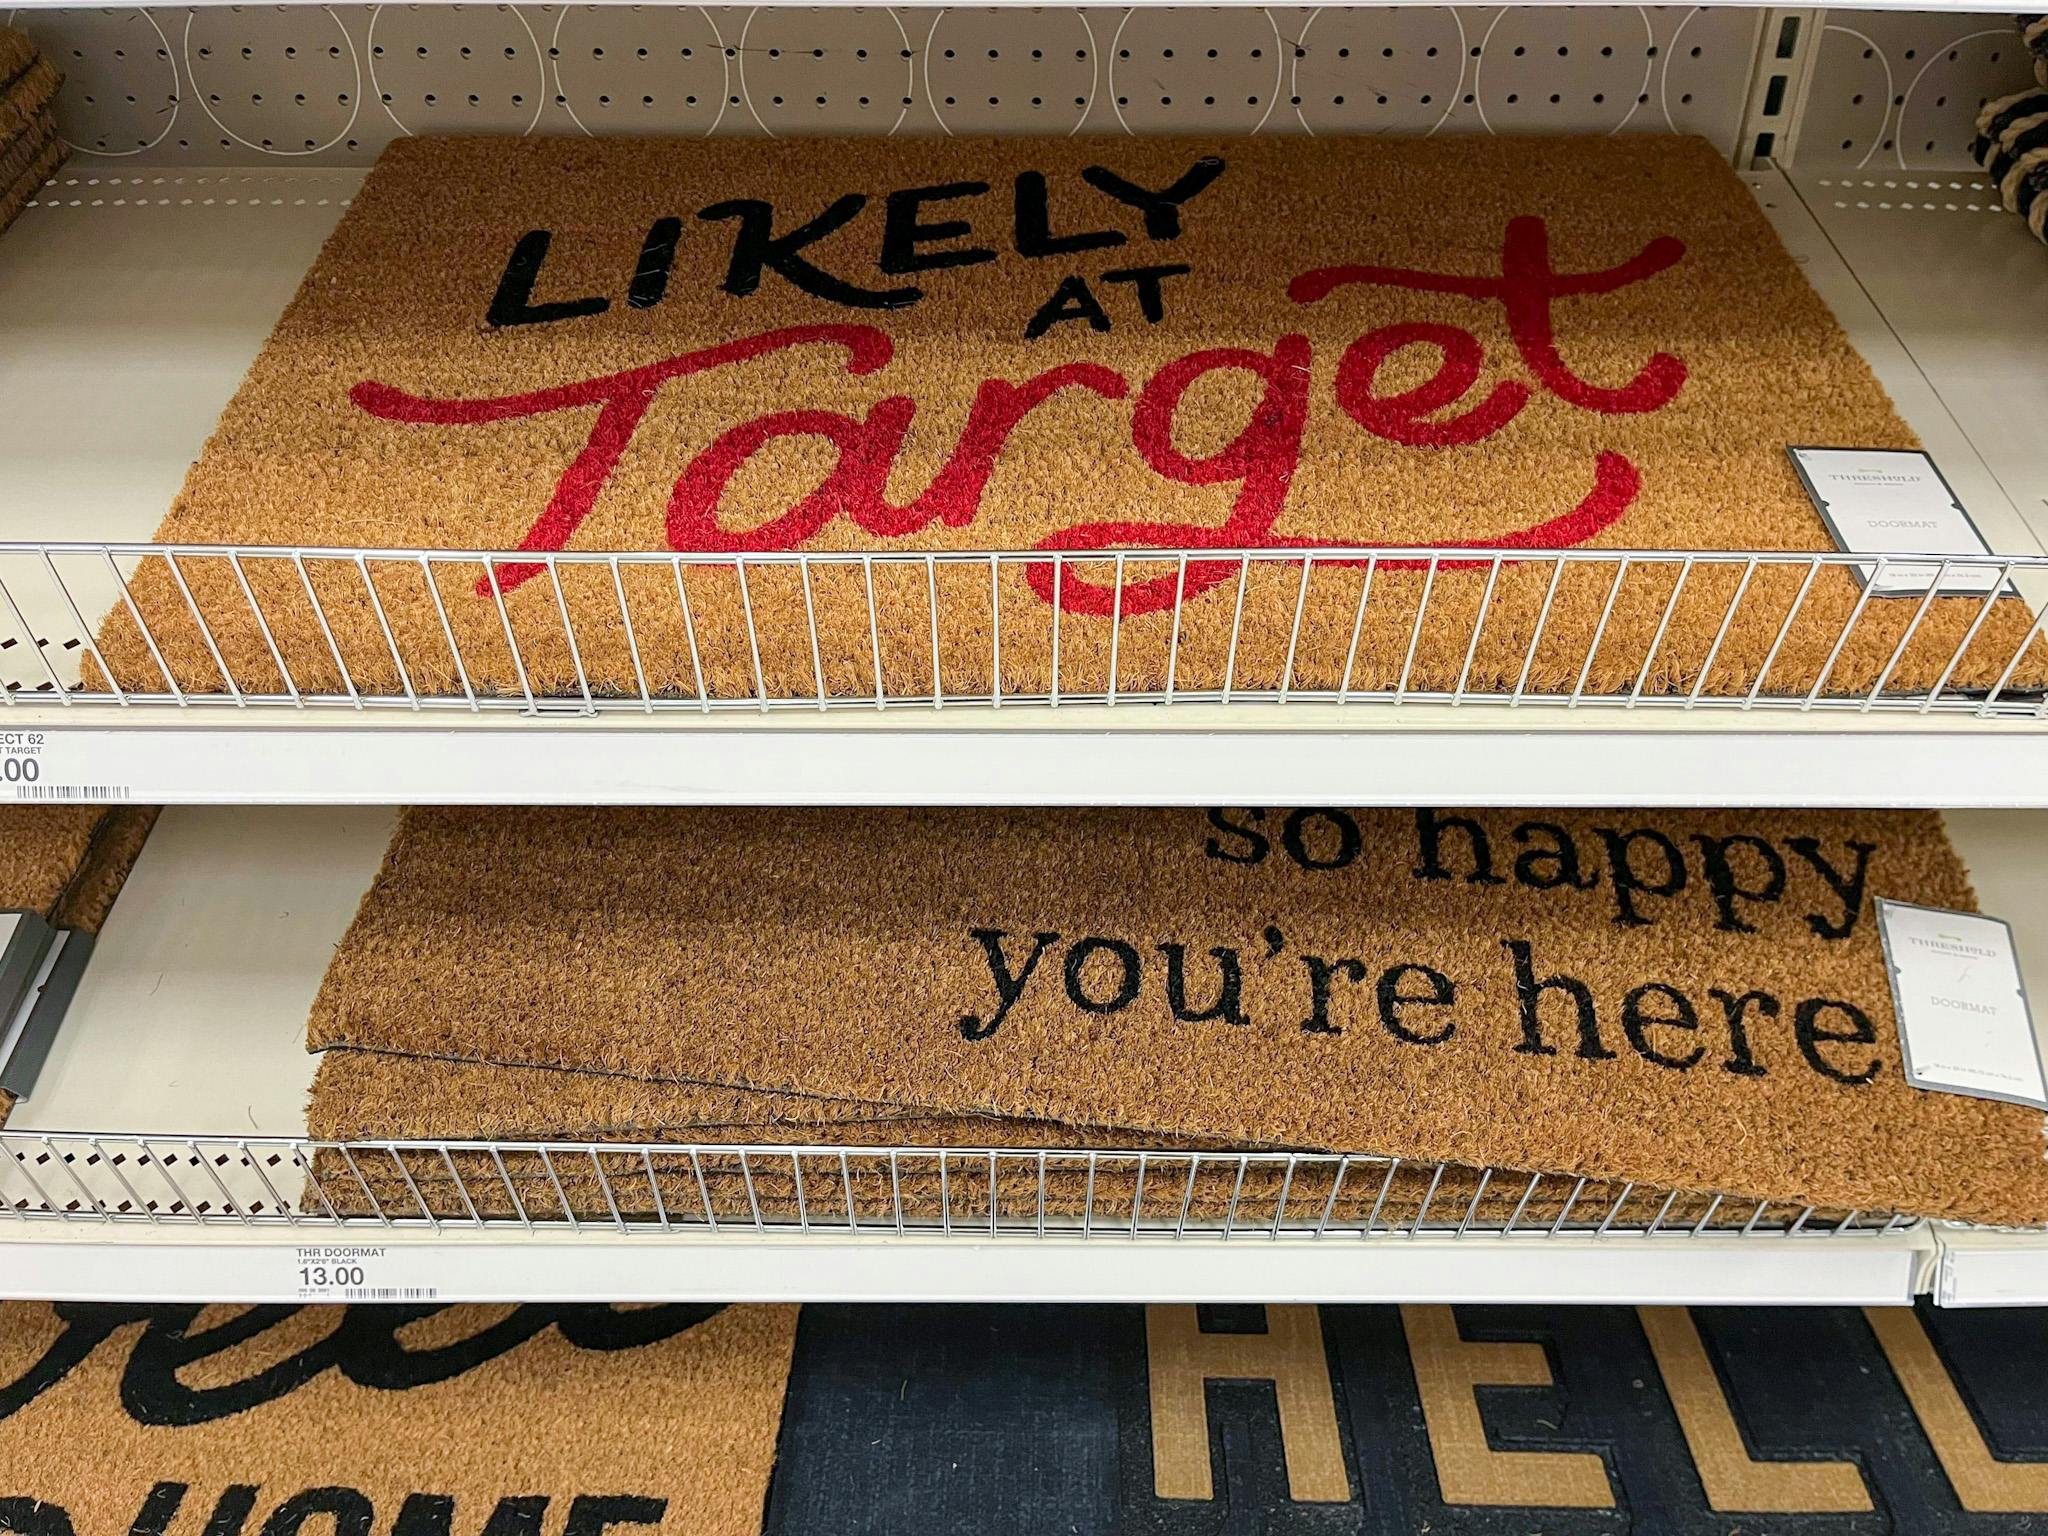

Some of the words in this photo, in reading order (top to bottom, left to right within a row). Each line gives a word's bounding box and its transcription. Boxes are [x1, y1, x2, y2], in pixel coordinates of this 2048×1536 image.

[486, 155, 1226, 330] LIKELY
[1023, 263, 1192, 341] AT
[351, 216, 1687, 617] Target
[1867, 519, 1938, 528] DOORMAT
[28, 733, 44, 744] 62
[5, 746, 41, 754] TARGET
[1205, 808, 1363, 872] so
[1412, 808, 1878, 939] happy
[960, 925, 1457, 1044] you're
[1501, 938, 1882, 1086] here
[1930, 996, 1997, 1016] DOORMAT
[296, 1247, 321, 1257] THR
[324, 1247, 387, 1257] DOORMAT
[299, 1266, 365, 1286] 13.00
